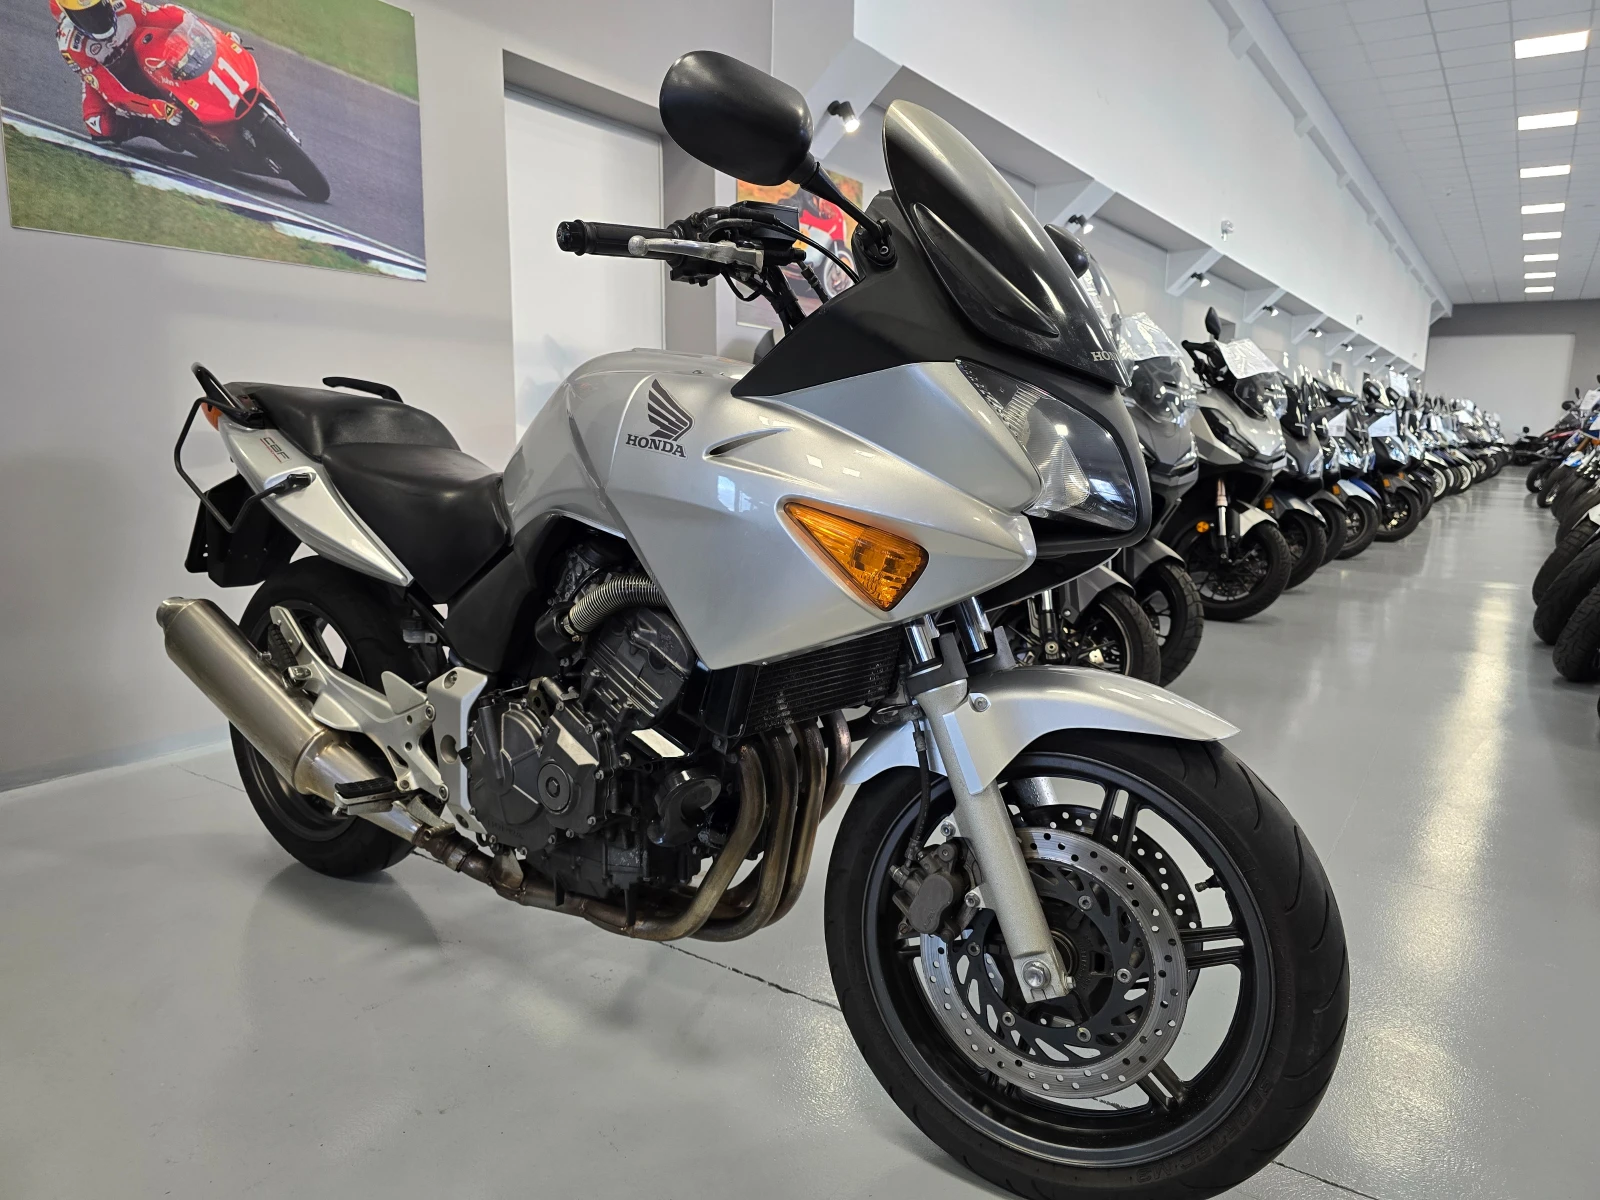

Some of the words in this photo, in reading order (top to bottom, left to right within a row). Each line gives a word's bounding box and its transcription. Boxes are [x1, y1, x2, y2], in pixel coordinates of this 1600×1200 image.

[208, 57, 249, 109] 11
[263, 436, 290, 460] CBF
[625, 433, 686, 458] HONDA
